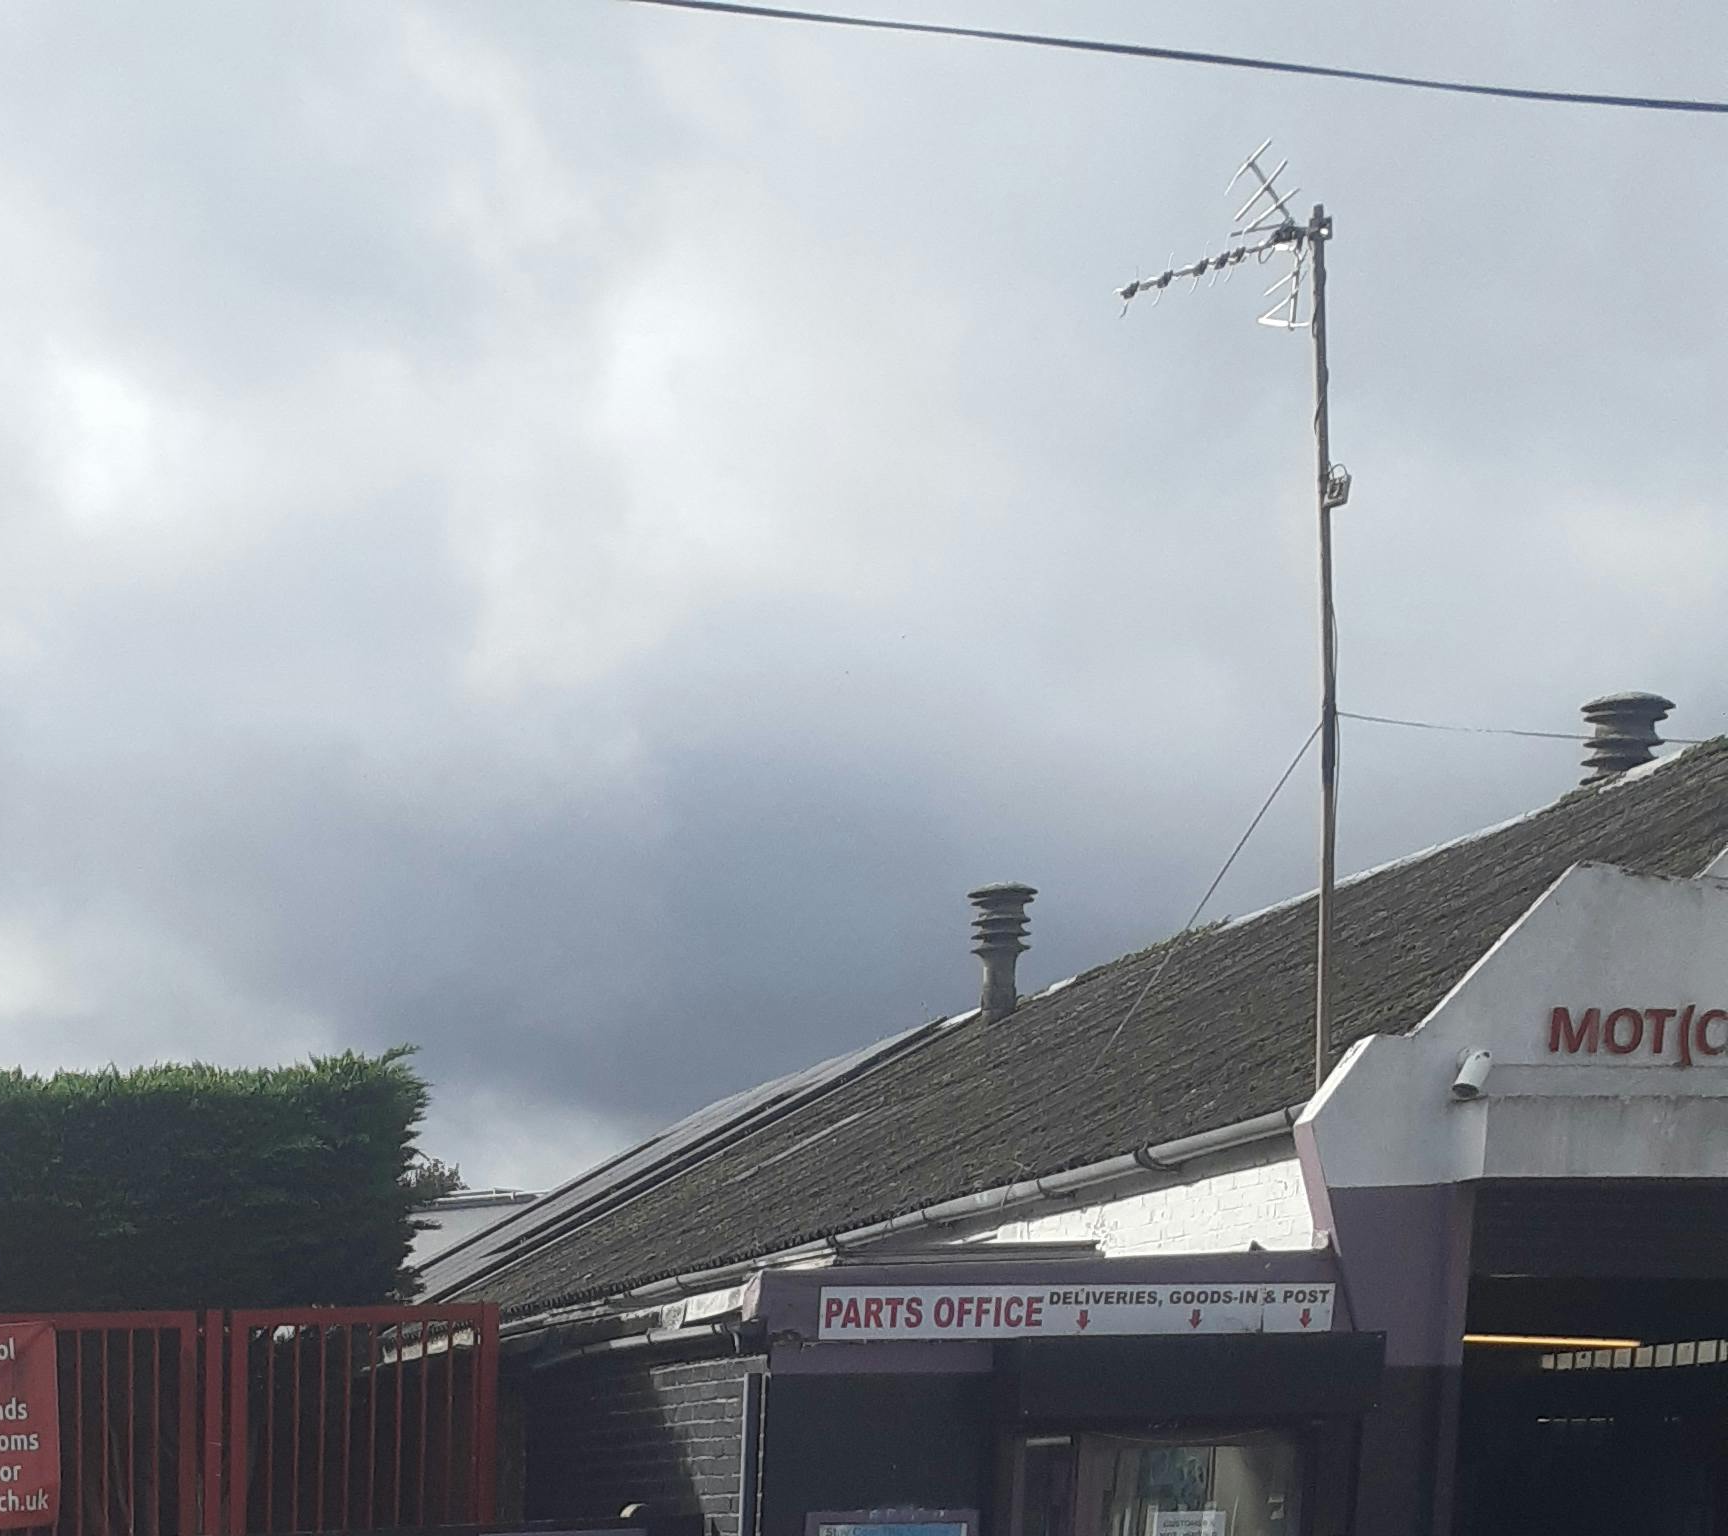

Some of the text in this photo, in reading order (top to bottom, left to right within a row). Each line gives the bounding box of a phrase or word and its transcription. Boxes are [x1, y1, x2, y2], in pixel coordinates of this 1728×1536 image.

[1049, 1289, 1330, 1307] DELIVERIES, GOODS-IN & POST
[824, 1296, 1044, 1328] PARTS OFFICE
[0, 1464, 22, 1482] or
